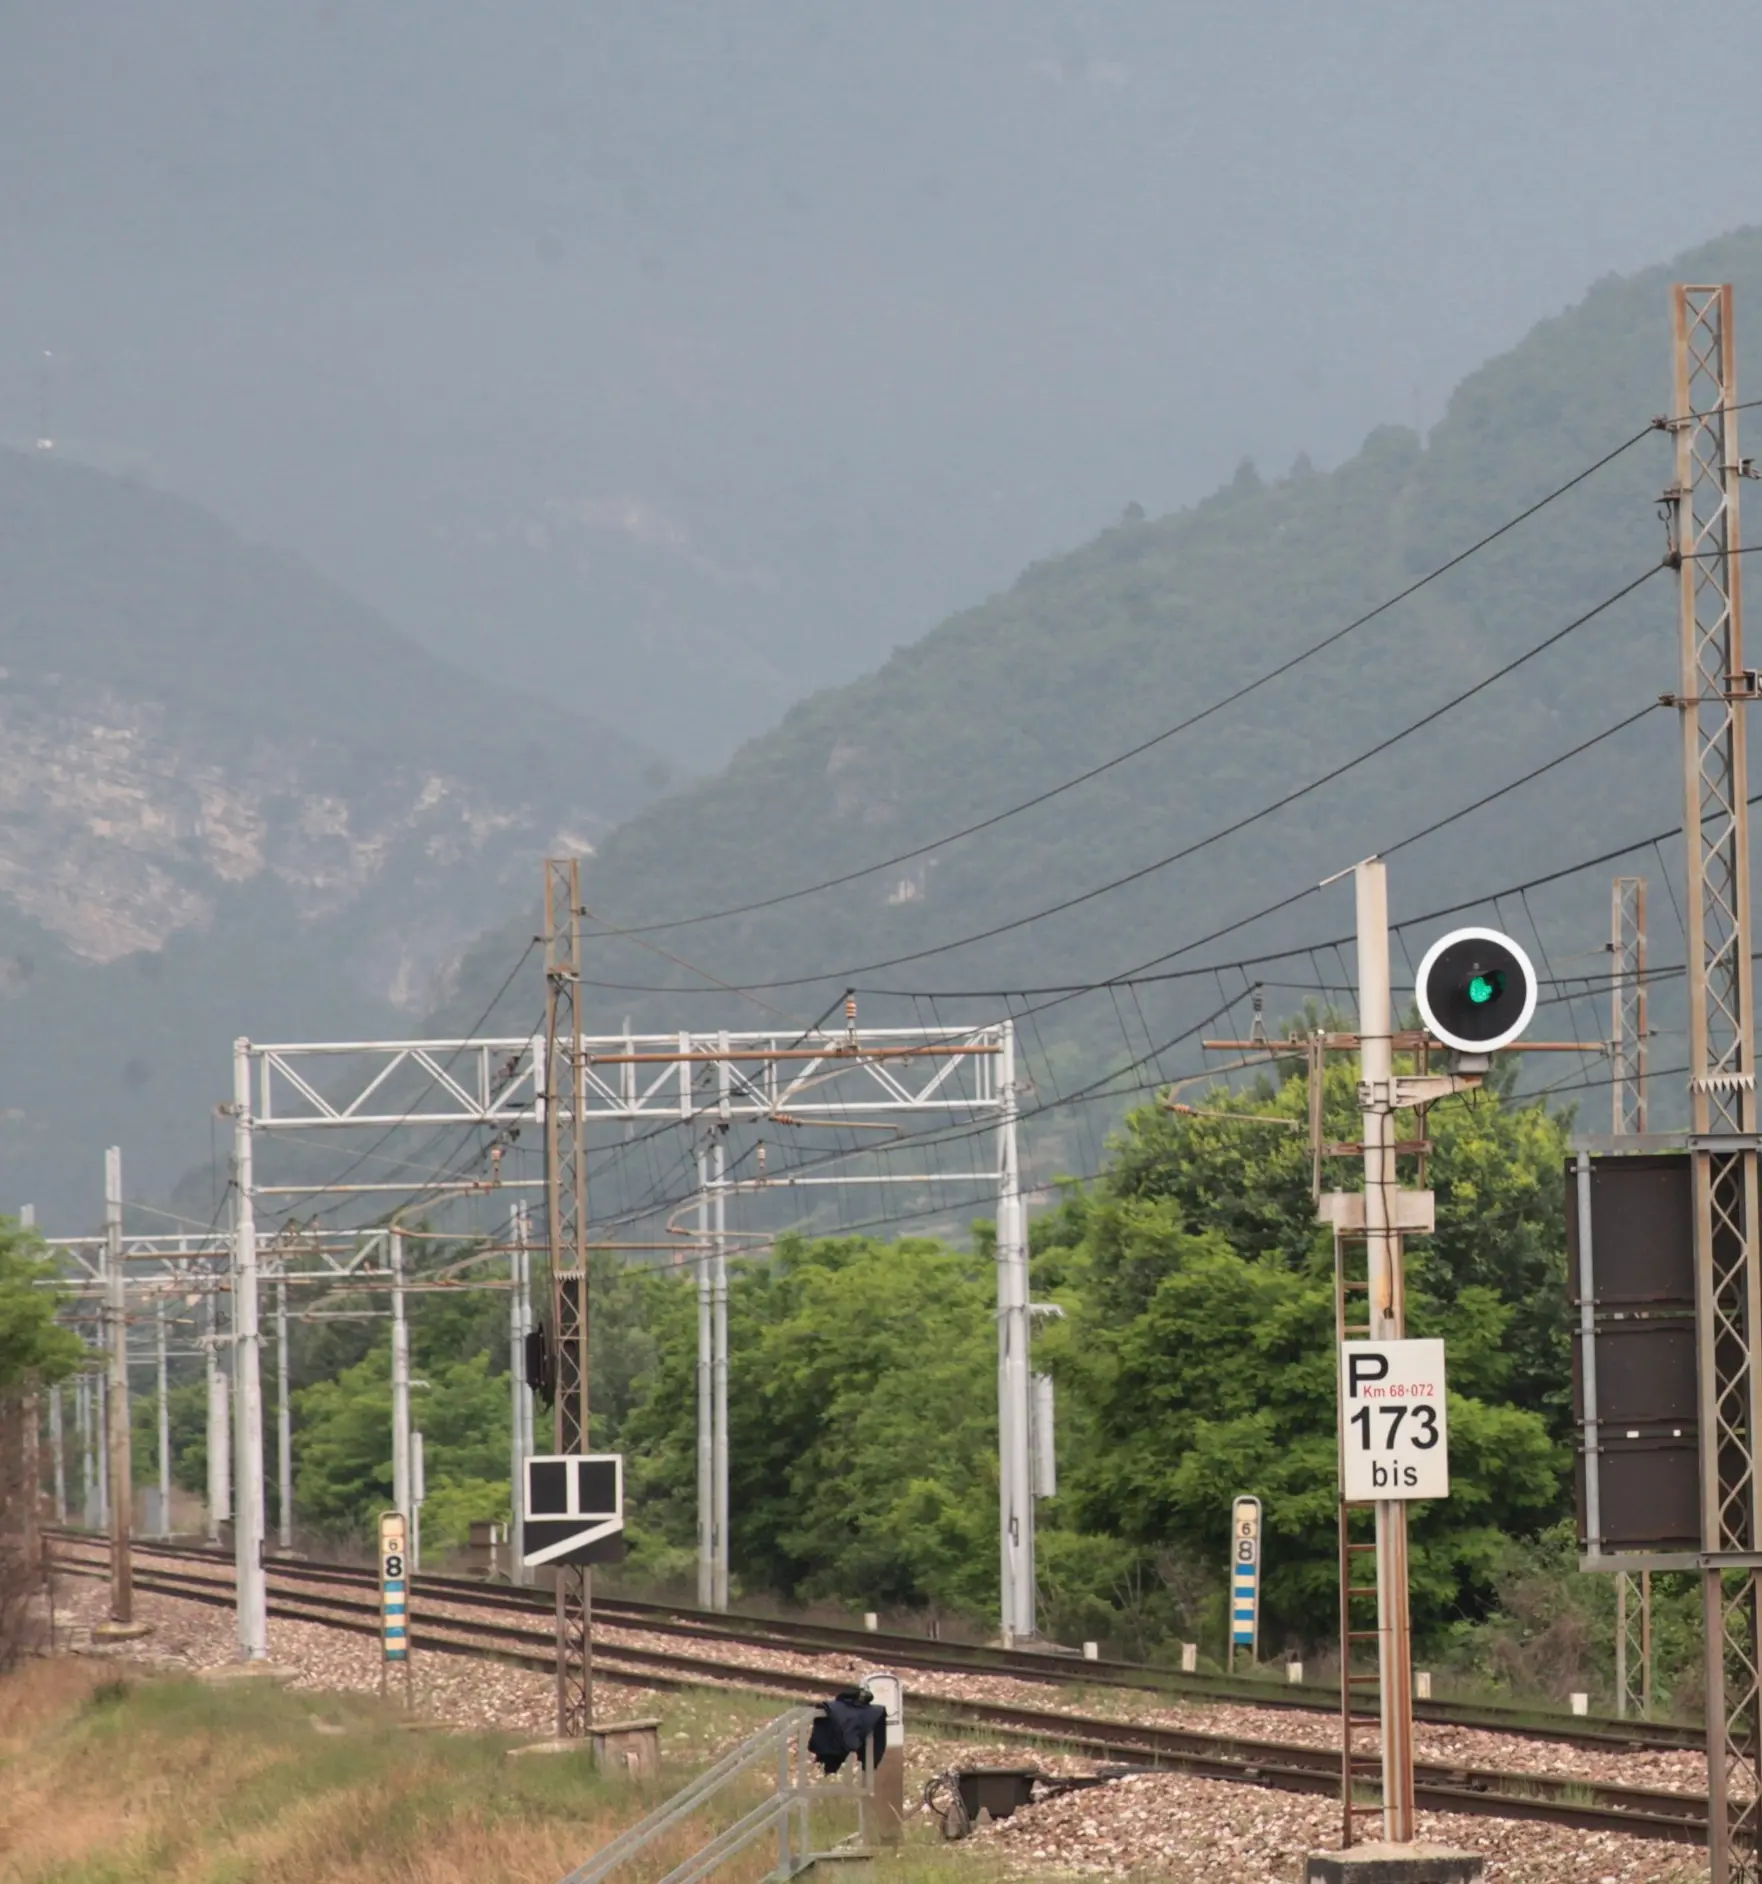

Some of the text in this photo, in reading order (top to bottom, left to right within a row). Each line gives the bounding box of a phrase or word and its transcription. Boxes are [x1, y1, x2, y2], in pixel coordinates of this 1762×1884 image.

[1349, 1354, 1389, 1398] P
[1363, 1386, 1386, 1398] Km
[1350, 1405, 1439, 1450] 173
[1372, 1460, 1418, 1487] bis
[1242, 1523, 1251, 1536] 6
[1238, 1540, 1252, 1561] 8
[386, 1556, 402, 1577] 8
